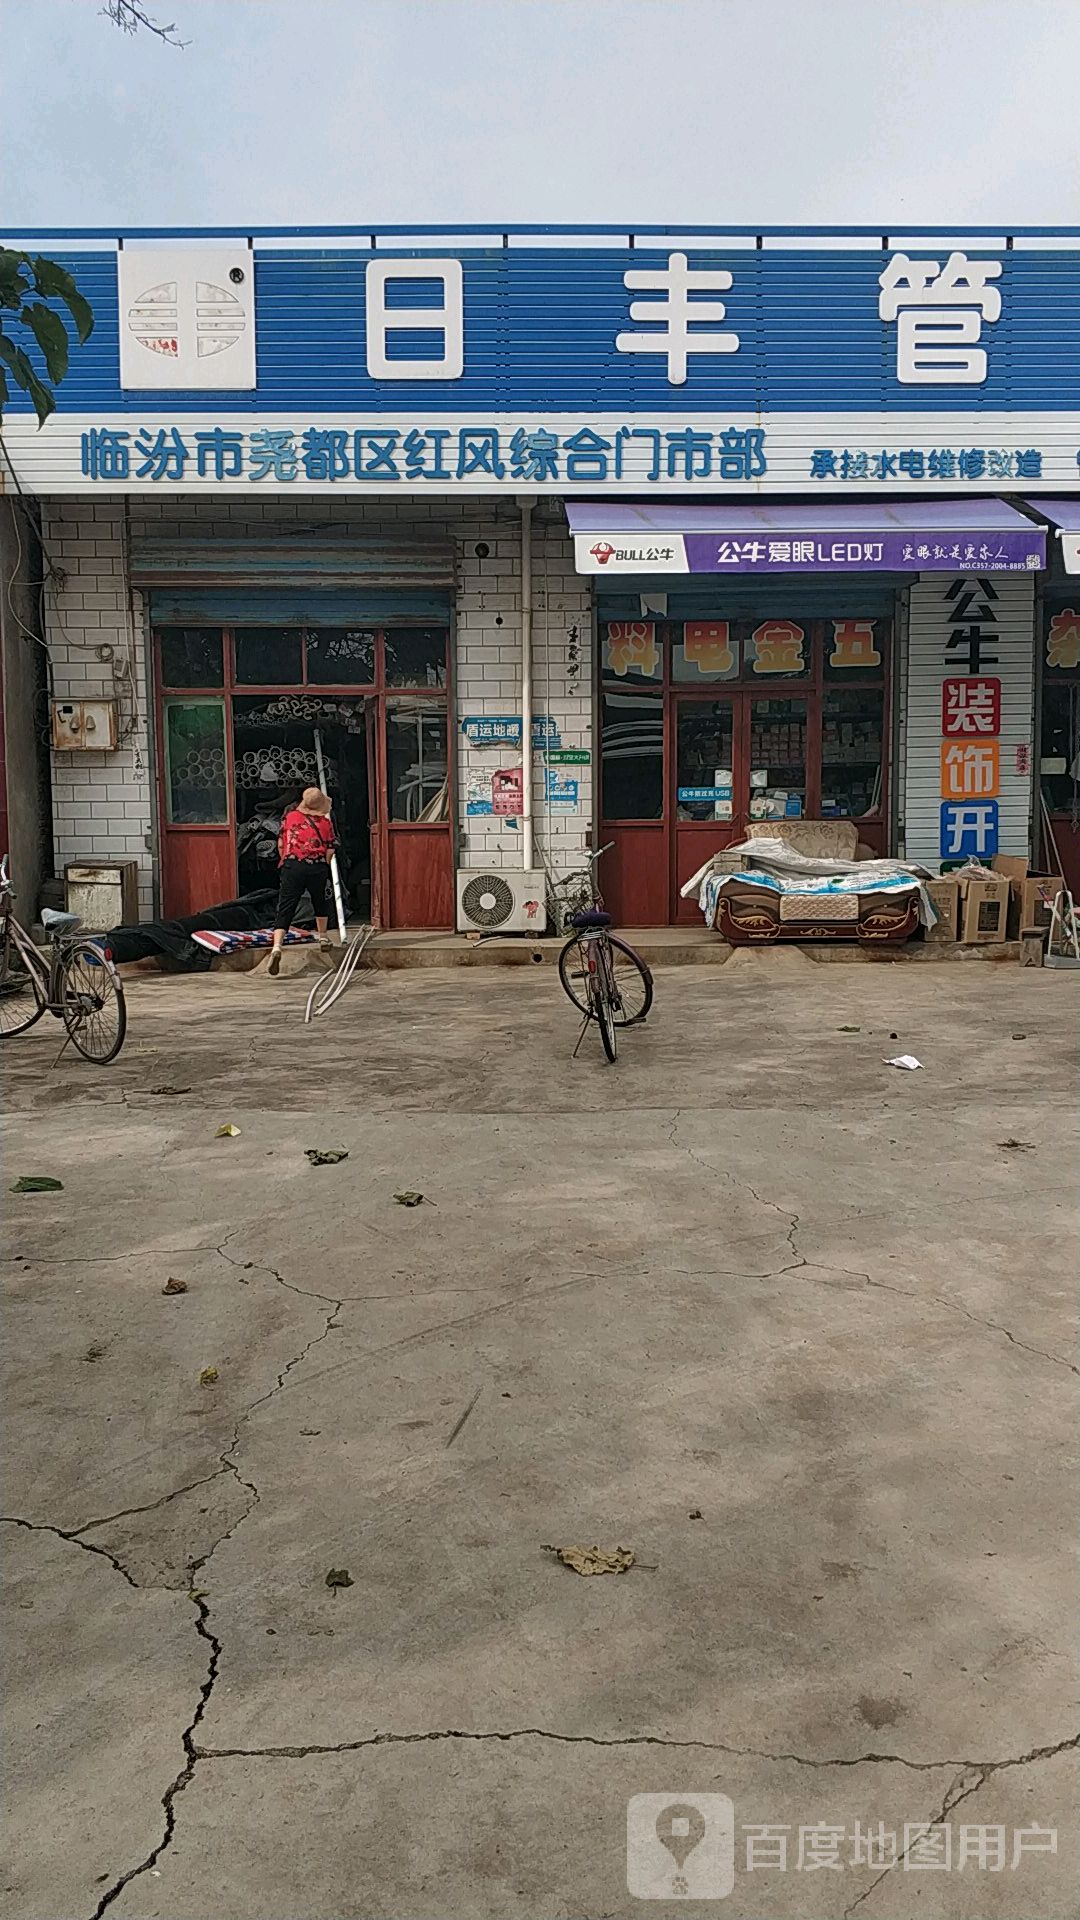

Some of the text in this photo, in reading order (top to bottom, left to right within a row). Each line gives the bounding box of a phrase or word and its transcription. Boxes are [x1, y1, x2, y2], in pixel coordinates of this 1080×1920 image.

[81, 427, 767, 481] 临汾市尧都区红风综合门市部
[810, 448, 1042, 479] 承接水电维修改造
[717, 541, 883, 564] 公牛爱眼LED灯
[466, 723, 520, 737] 盾运地暖
